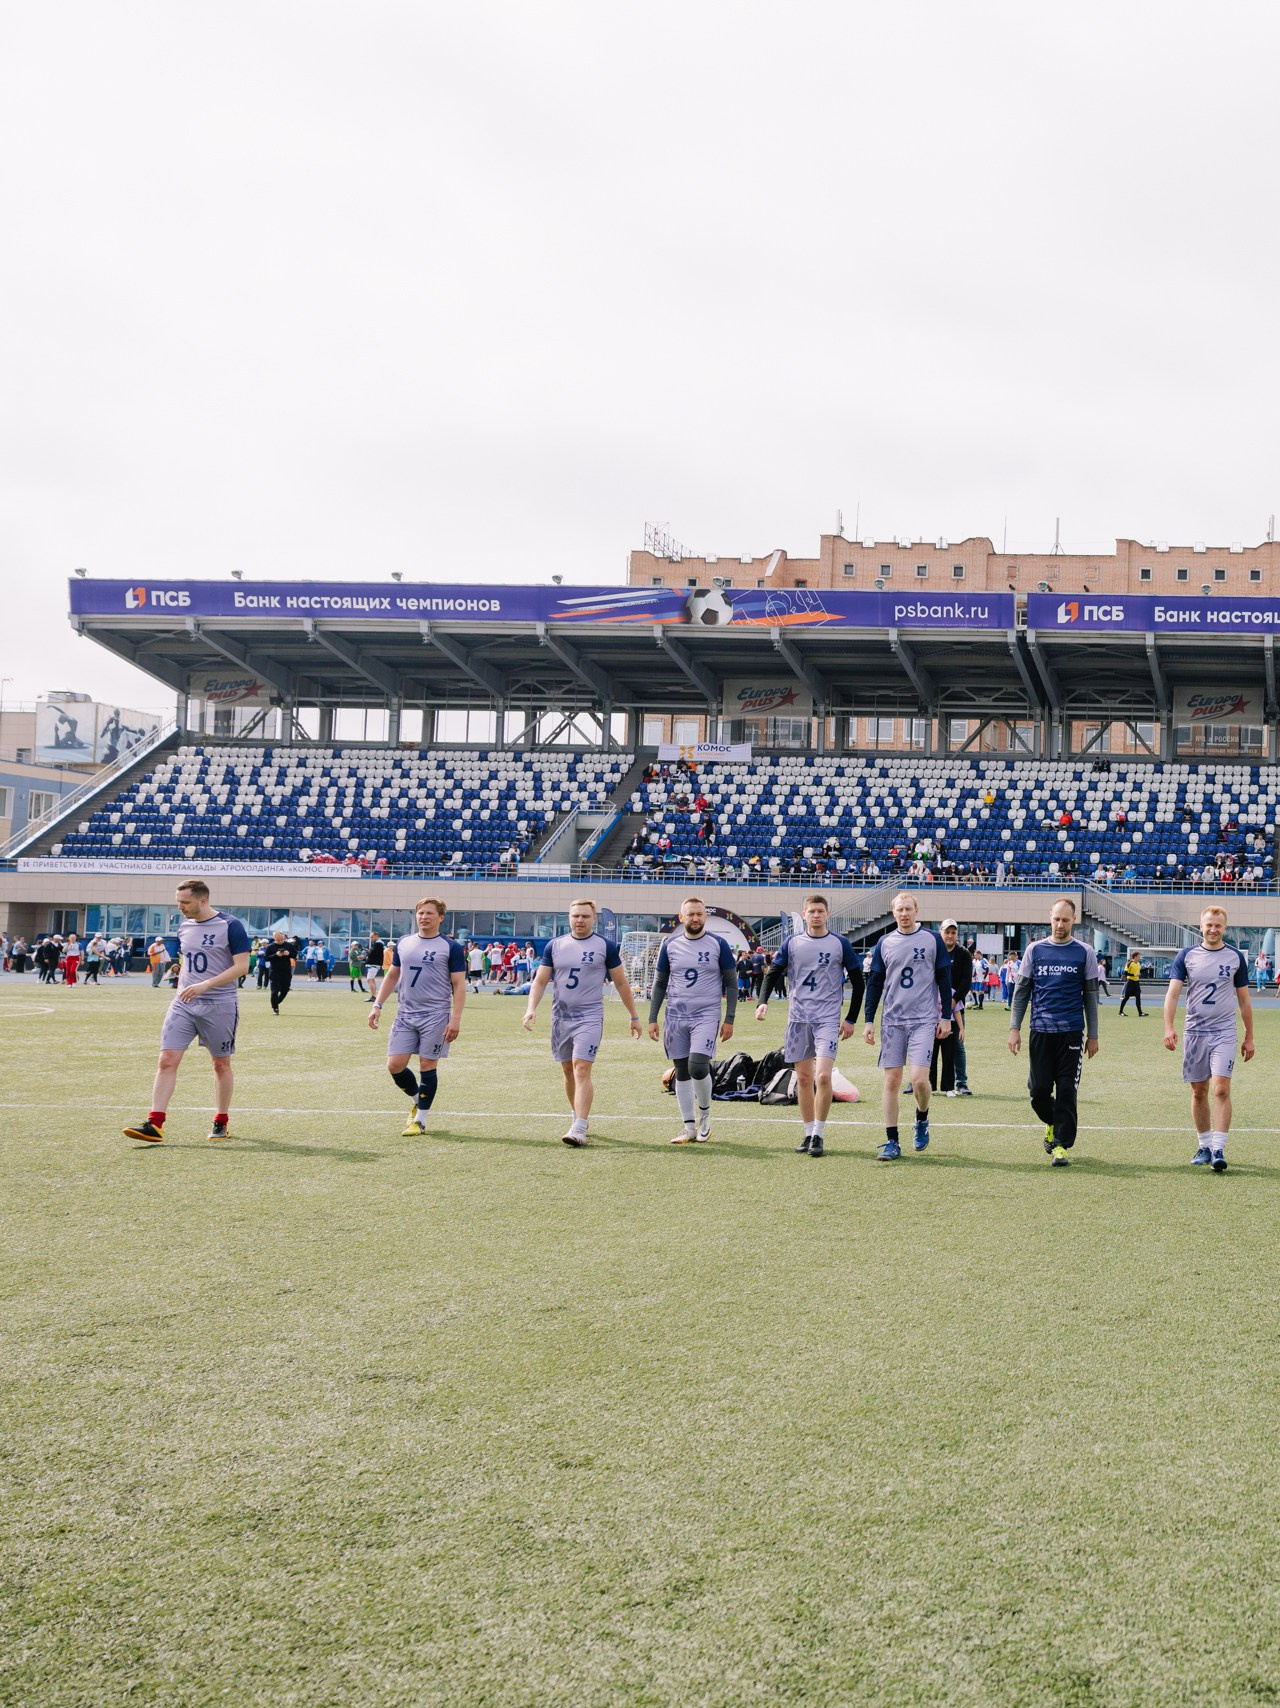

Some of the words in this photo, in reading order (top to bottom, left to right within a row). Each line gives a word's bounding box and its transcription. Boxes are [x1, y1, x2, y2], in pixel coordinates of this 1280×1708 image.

[151, 590, 191, 607] ПСБ
[233, 591, 280, 608] Банк
[286, 596, 391, 613] настоящих
[396, 596, 501, 612] чемпионов
[895, 602, 989, 621] psbank.ru
[1084, 605, 1125, 621] ПСБ
[1153, 606, 1201, 623] Банк
[697, 744, 732, 752] КОМОС
[33, 861, 95, 869] ПРИВЕТСТВУЕМ
[99, 862, 152, 870] УЧАСТНИКОВ
[156, 863, 217, 872] СПАРТАКИАДЫ
[220, 864, 285, 873] АГРОХОЛДИНГА
[288, 865, 323, 873] «КОМОС
[326, 866, 357, 874] ГРУПП»
[186, 952, 208, 973] 10
[1048, 965, 1078, 973] КОМОС
[409, 966, 423, 988] 7
[565, 968, 581, 990] 5
[684, 968, 698, 988] 9
[802, 970, 817, 991] 4
[900, 966, 914, 989] 8
[1202, 983, 1217, 1005] 2
